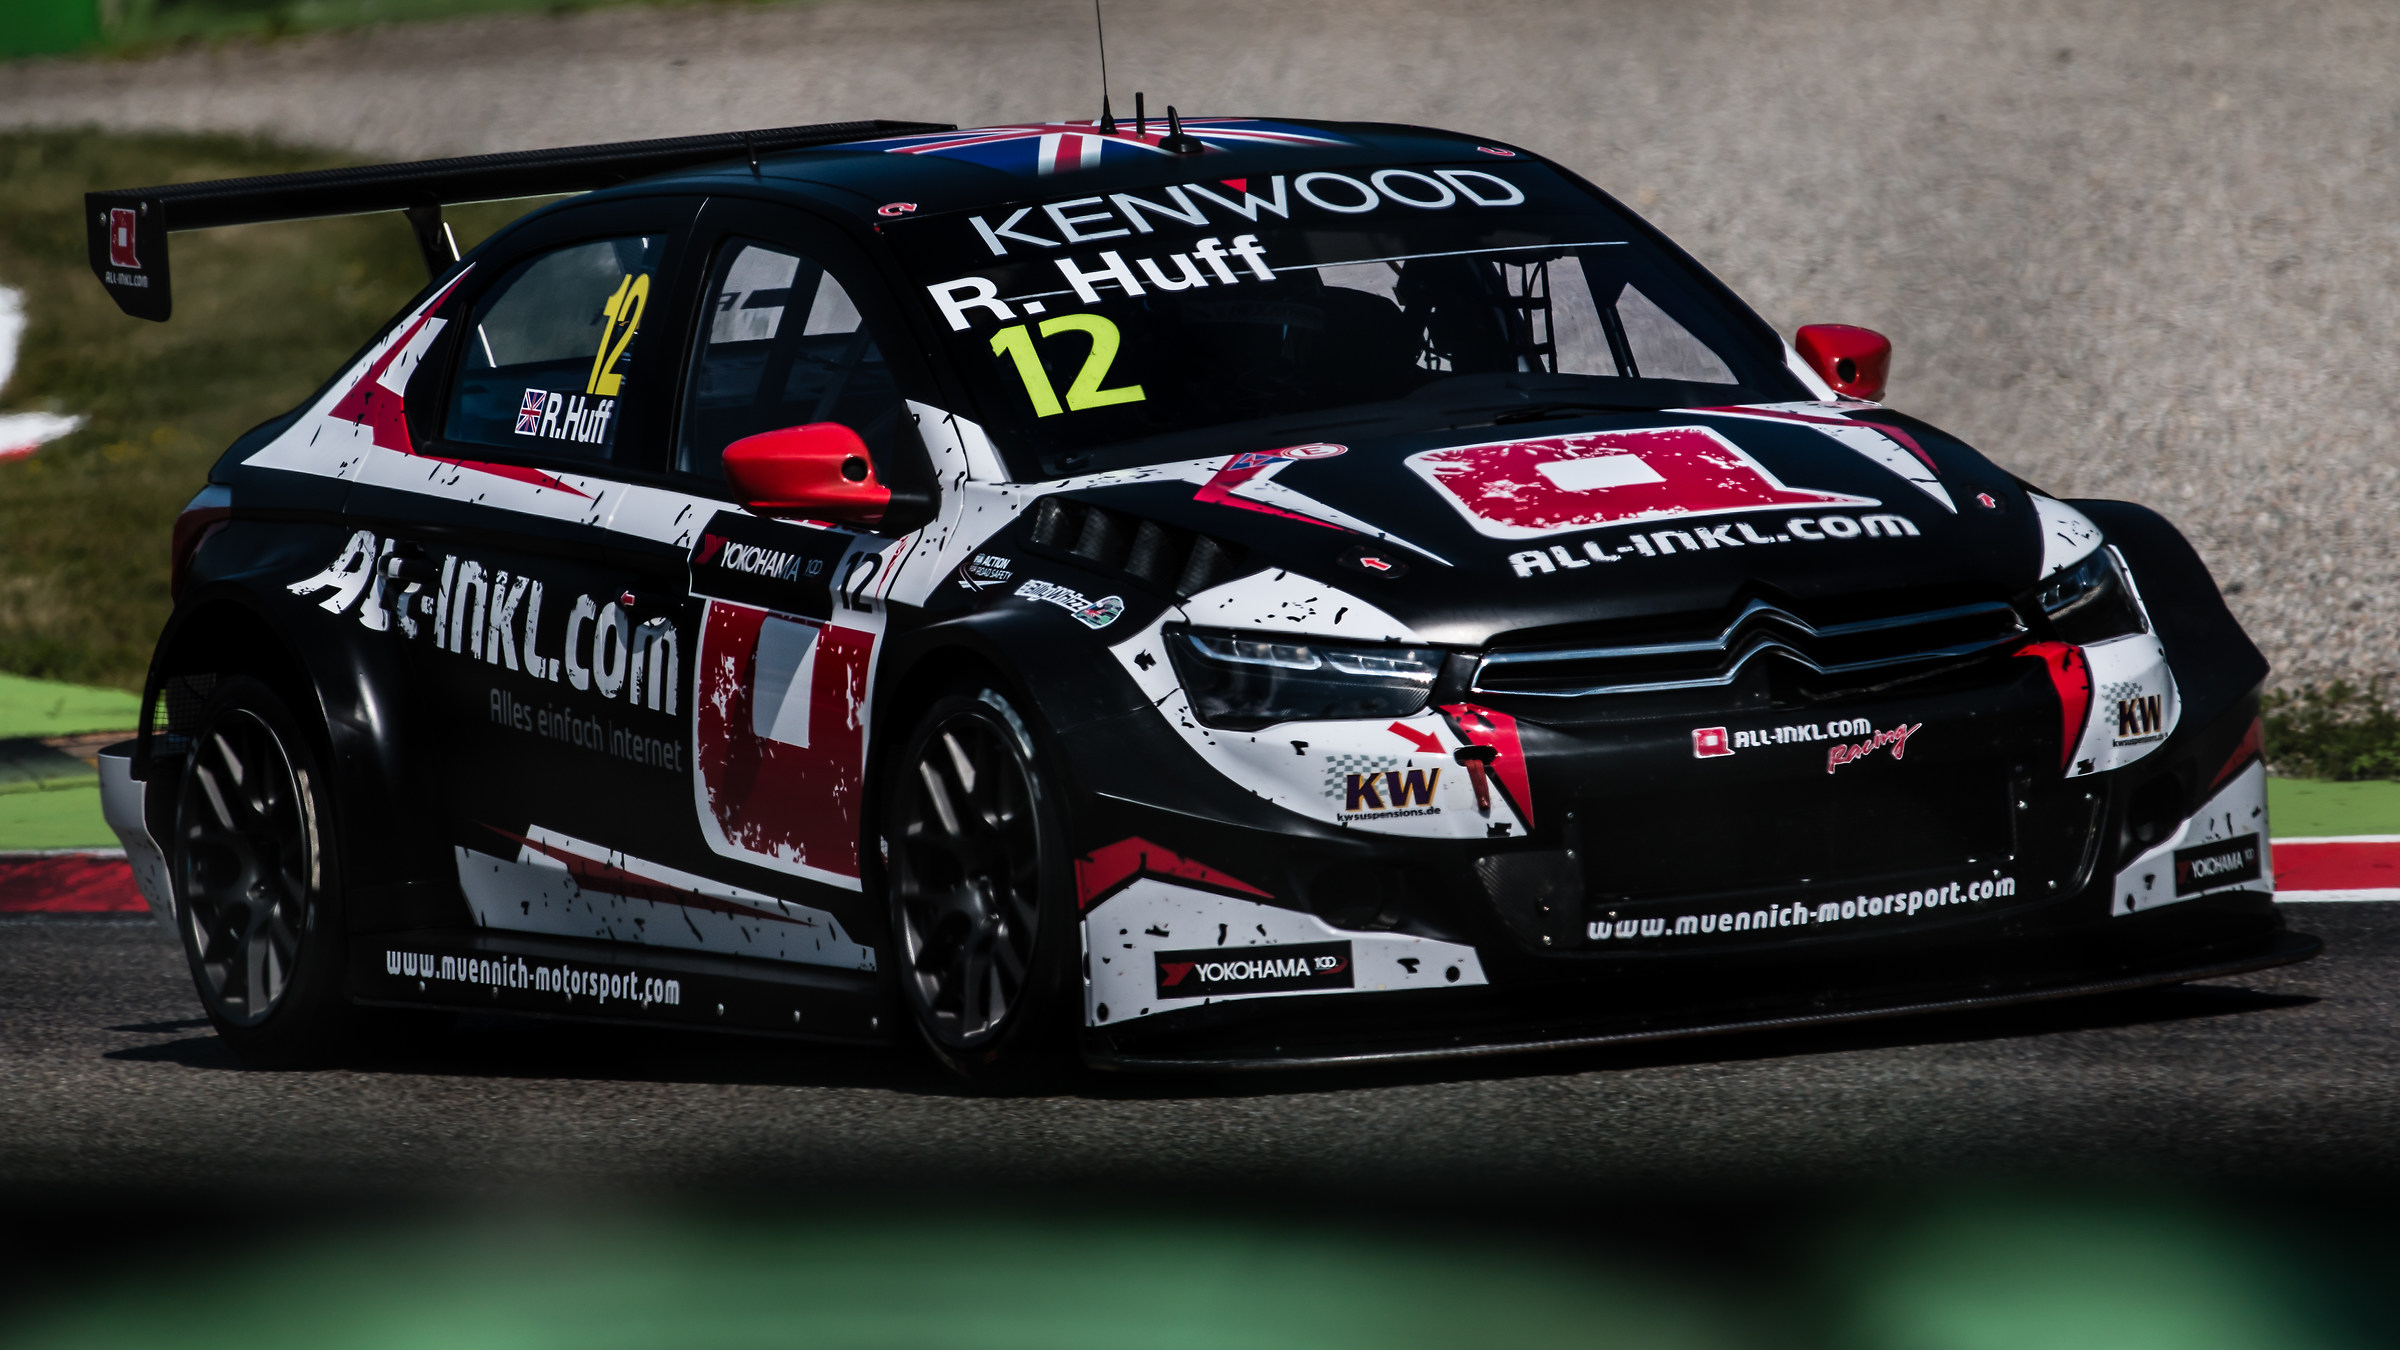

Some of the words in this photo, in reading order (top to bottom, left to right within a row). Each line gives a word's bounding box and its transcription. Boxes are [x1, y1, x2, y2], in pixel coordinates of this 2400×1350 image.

[967, 168, 1526, 256] KENWOOD
[926, 276, 1047, 332] R.
[1054, 234, 1278, 306] Huff
[586, 273, 650, 396] 12
[988, 313, 1147, 418] 12
[539, 392, 616, 444] R.Huff
[719, 541, 803, 583] YOKOHAMA
[840, 551, 883, 614] 12
[981, 555, 1012, 570] ACTION
[489, 687, 533, 733] Alles
[537, 706, 603, 754] einfach
[608, 723, 683, 774] Internet
[2118, 694, 2162, 738] KW
[1825, 722, 1923, 775] Racing
[1337, 806, 1442, 823] kwsuspensions.de
[1345, 767, 1442, 812] KW
[2191, 851, 2244, 879] YOKOHAMA
[1586, 875, 2016, 940] www.muennich-motorsport.com
[386, 949, 681, 1006] www.muennich-motorsport.com
[1195, 957, 1313, 983] YOKOHAMA
